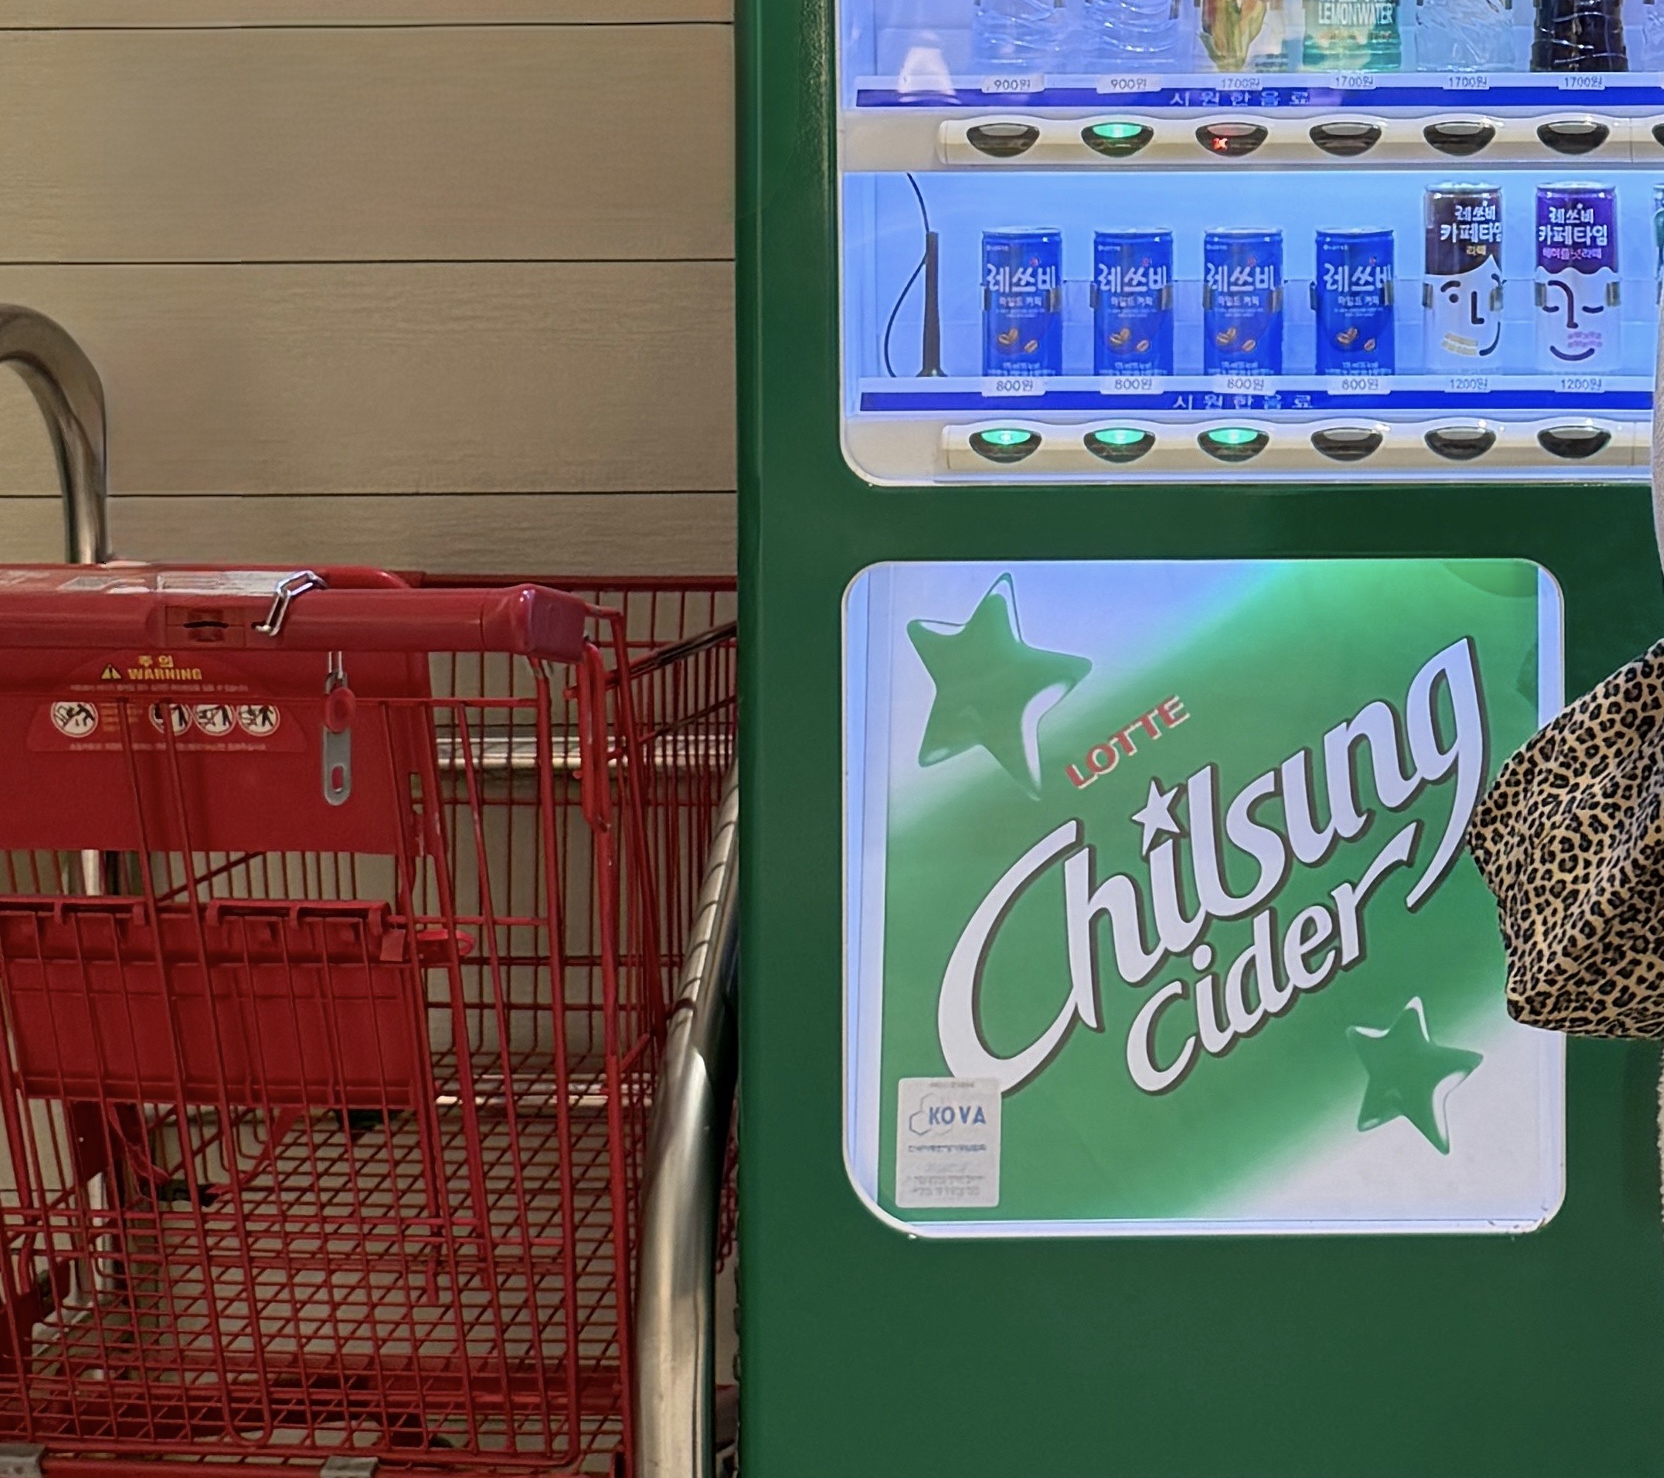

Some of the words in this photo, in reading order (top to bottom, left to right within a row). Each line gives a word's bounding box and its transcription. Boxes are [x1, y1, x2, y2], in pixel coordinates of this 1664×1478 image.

[1110, 78, 1147, 90] 900원
[1455, 201, 1496, 222] 레쓰비
[1549, 206, 1594, 224] 레쓰비
[1538, 224, 1608, 246] 카페타임
[987, 264, 1056, 294] 레쓰비
[1098, 264, 1167, 294] 레쓰비
[1206, 263, 1275, 293] 레쓰비
[1323, 263, 1391, 293] 레쓰비
[996, 379, 1033, 392] 800원
[1114, 378, 1152, 391] 800원
[127, 668, 203, 681] WARNING
[1064, 694, 1191, 790] LOTTE
[938, 636, 1488, 1097] Chilsung
[928, 1105, 987, 1126] KOVA
